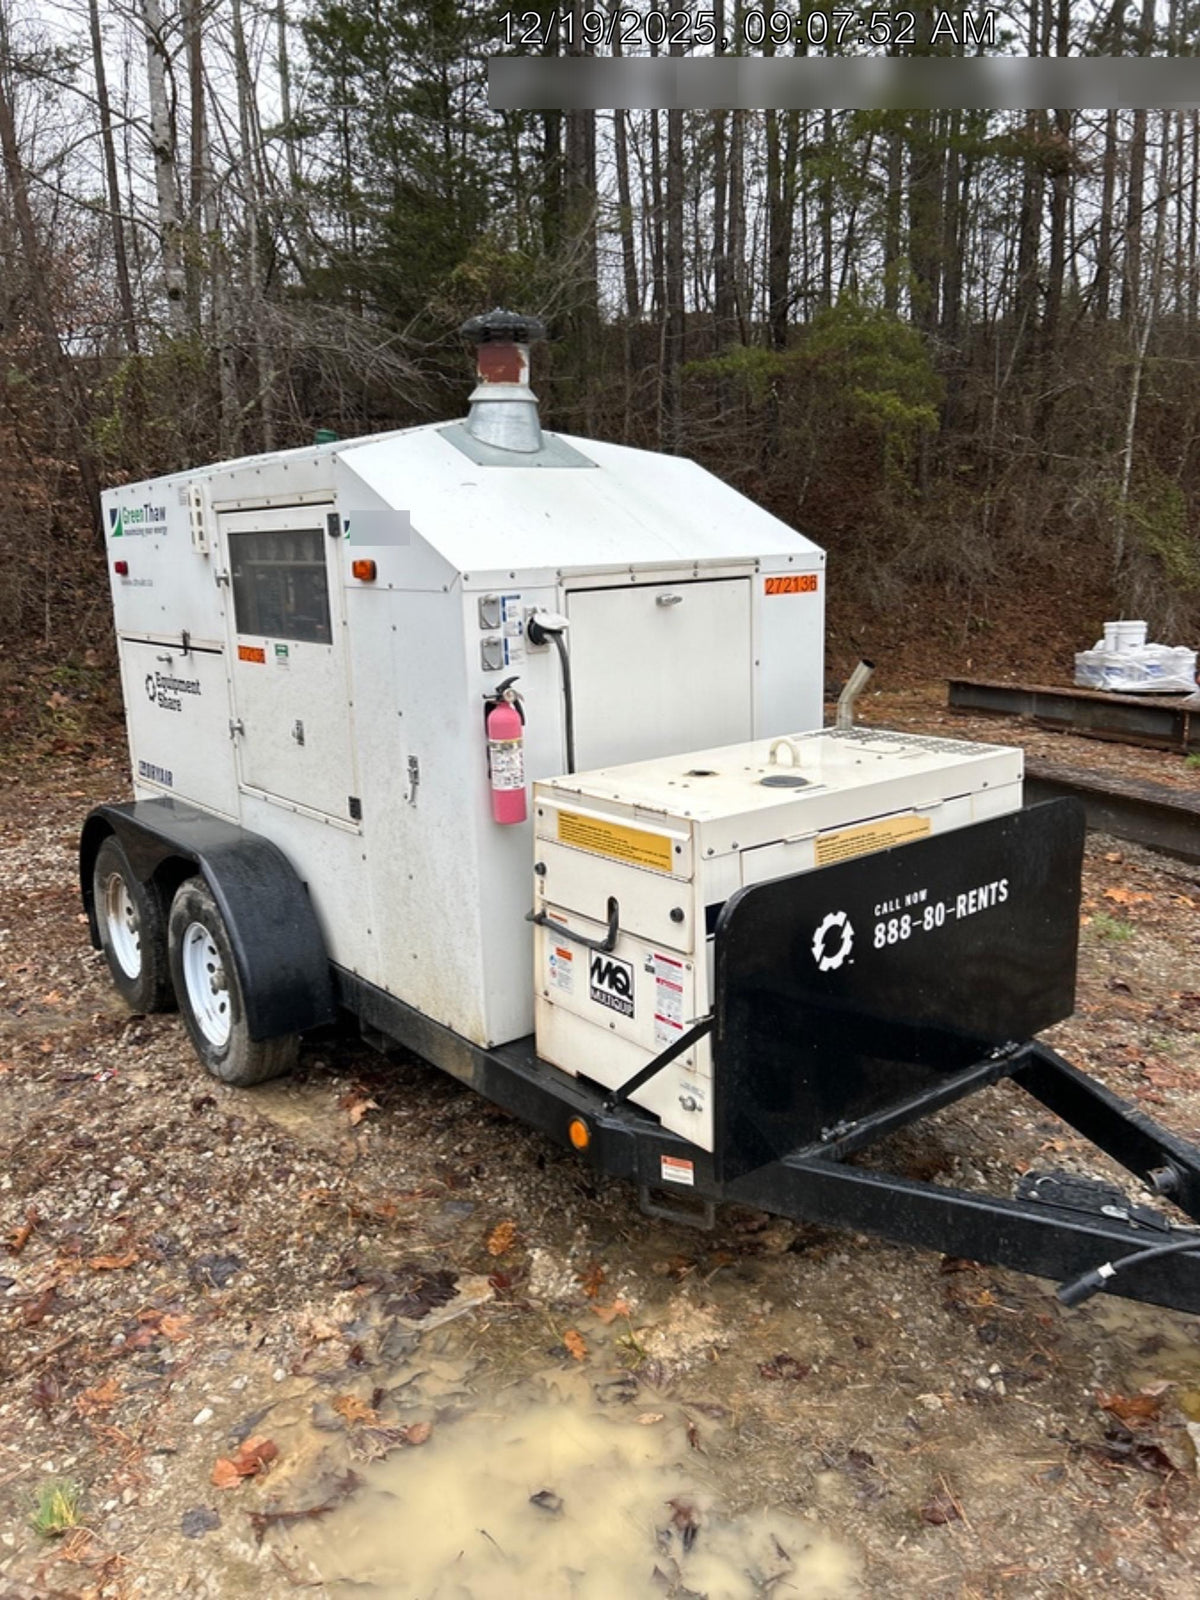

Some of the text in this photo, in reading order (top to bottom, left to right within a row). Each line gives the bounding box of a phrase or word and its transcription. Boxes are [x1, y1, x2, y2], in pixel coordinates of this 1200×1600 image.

[154, 671, 202, 696] Equipment
[158, 691, 182, 712] Share
[873, 878, 1010, 949] 888-80-RENTS
[874, 888, 928, 917] CALL NOW
